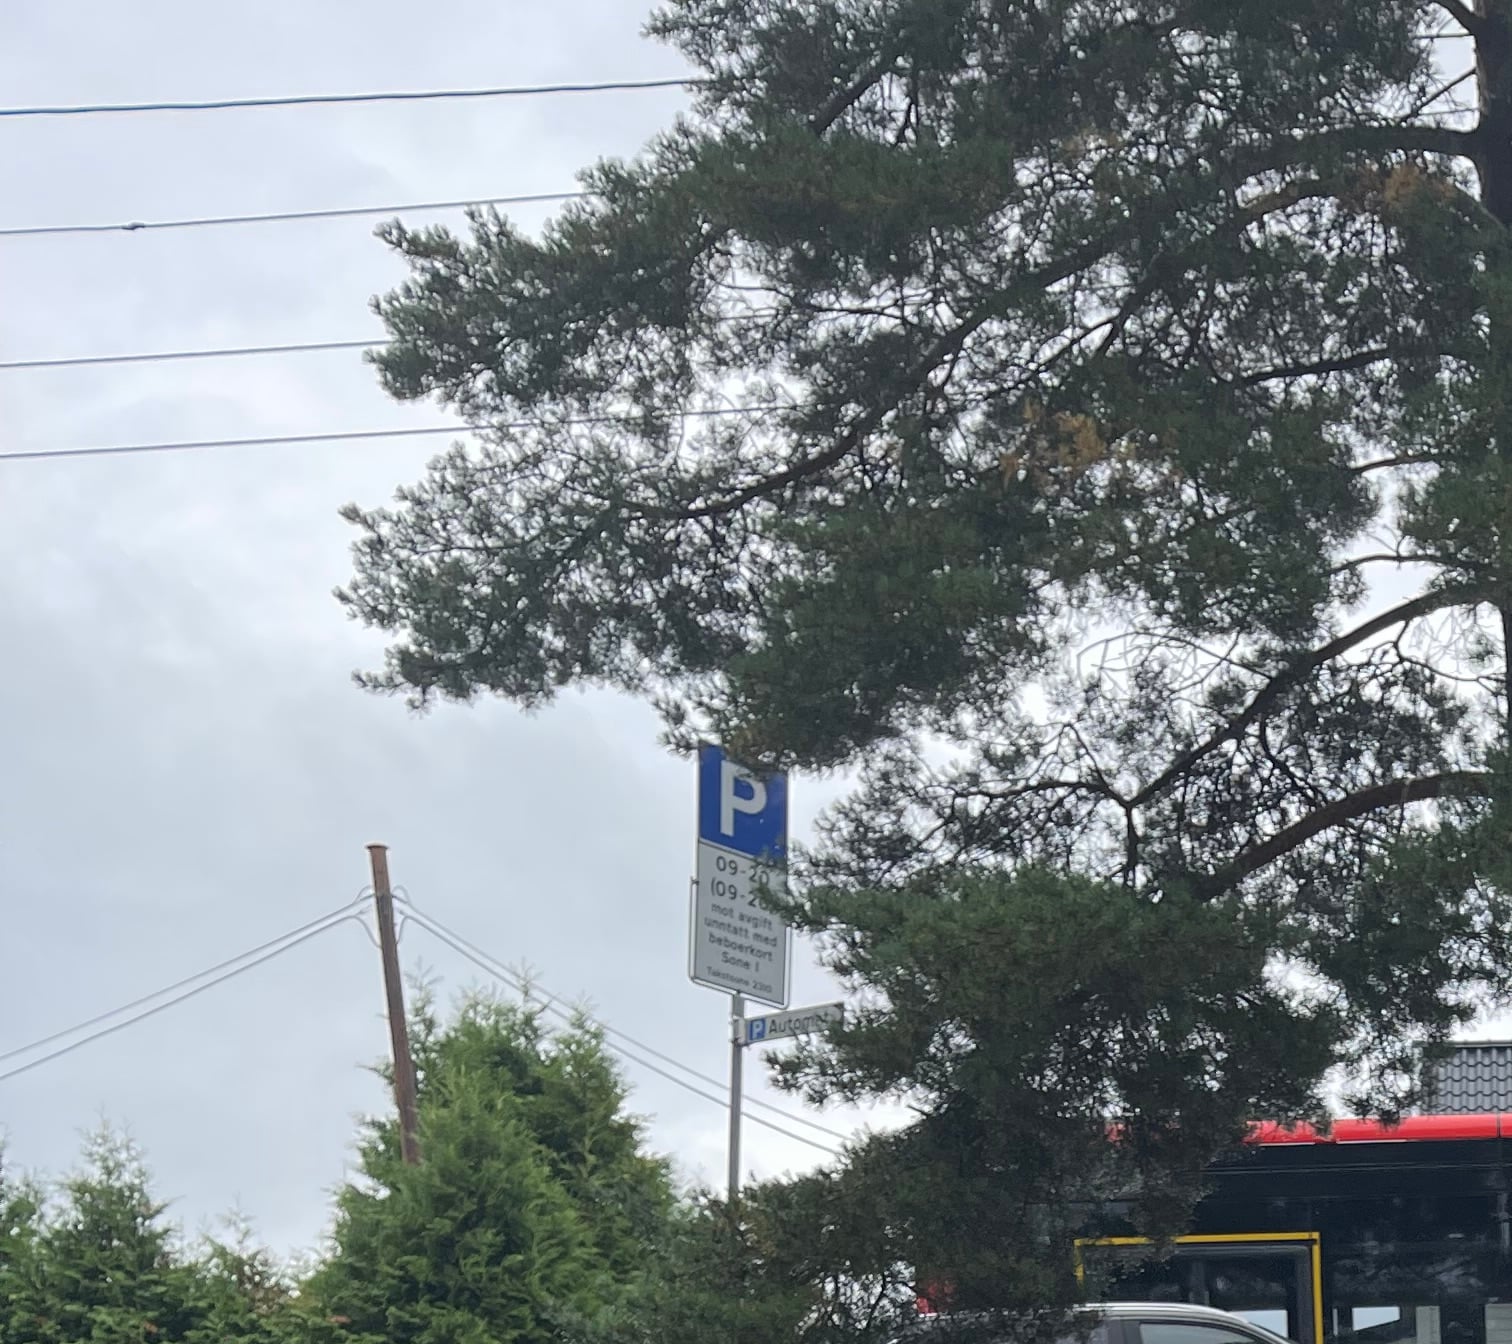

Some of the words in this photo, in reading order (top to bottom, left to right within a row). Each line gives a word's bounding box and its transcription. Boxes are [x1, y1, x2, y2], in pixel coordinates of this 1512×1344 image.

[721, 760, 767, 837] P
[716, 855, 769, 887] 09-20
[704, 917, 749, 939] unntatt
[752, 932, 777, 947] med
[711, 903, 734, 918] mot
[739, 912, 772, 931] avgift
[708, 932, 773, 962] beboerkort
[721, 951, 750, 970] Sone
